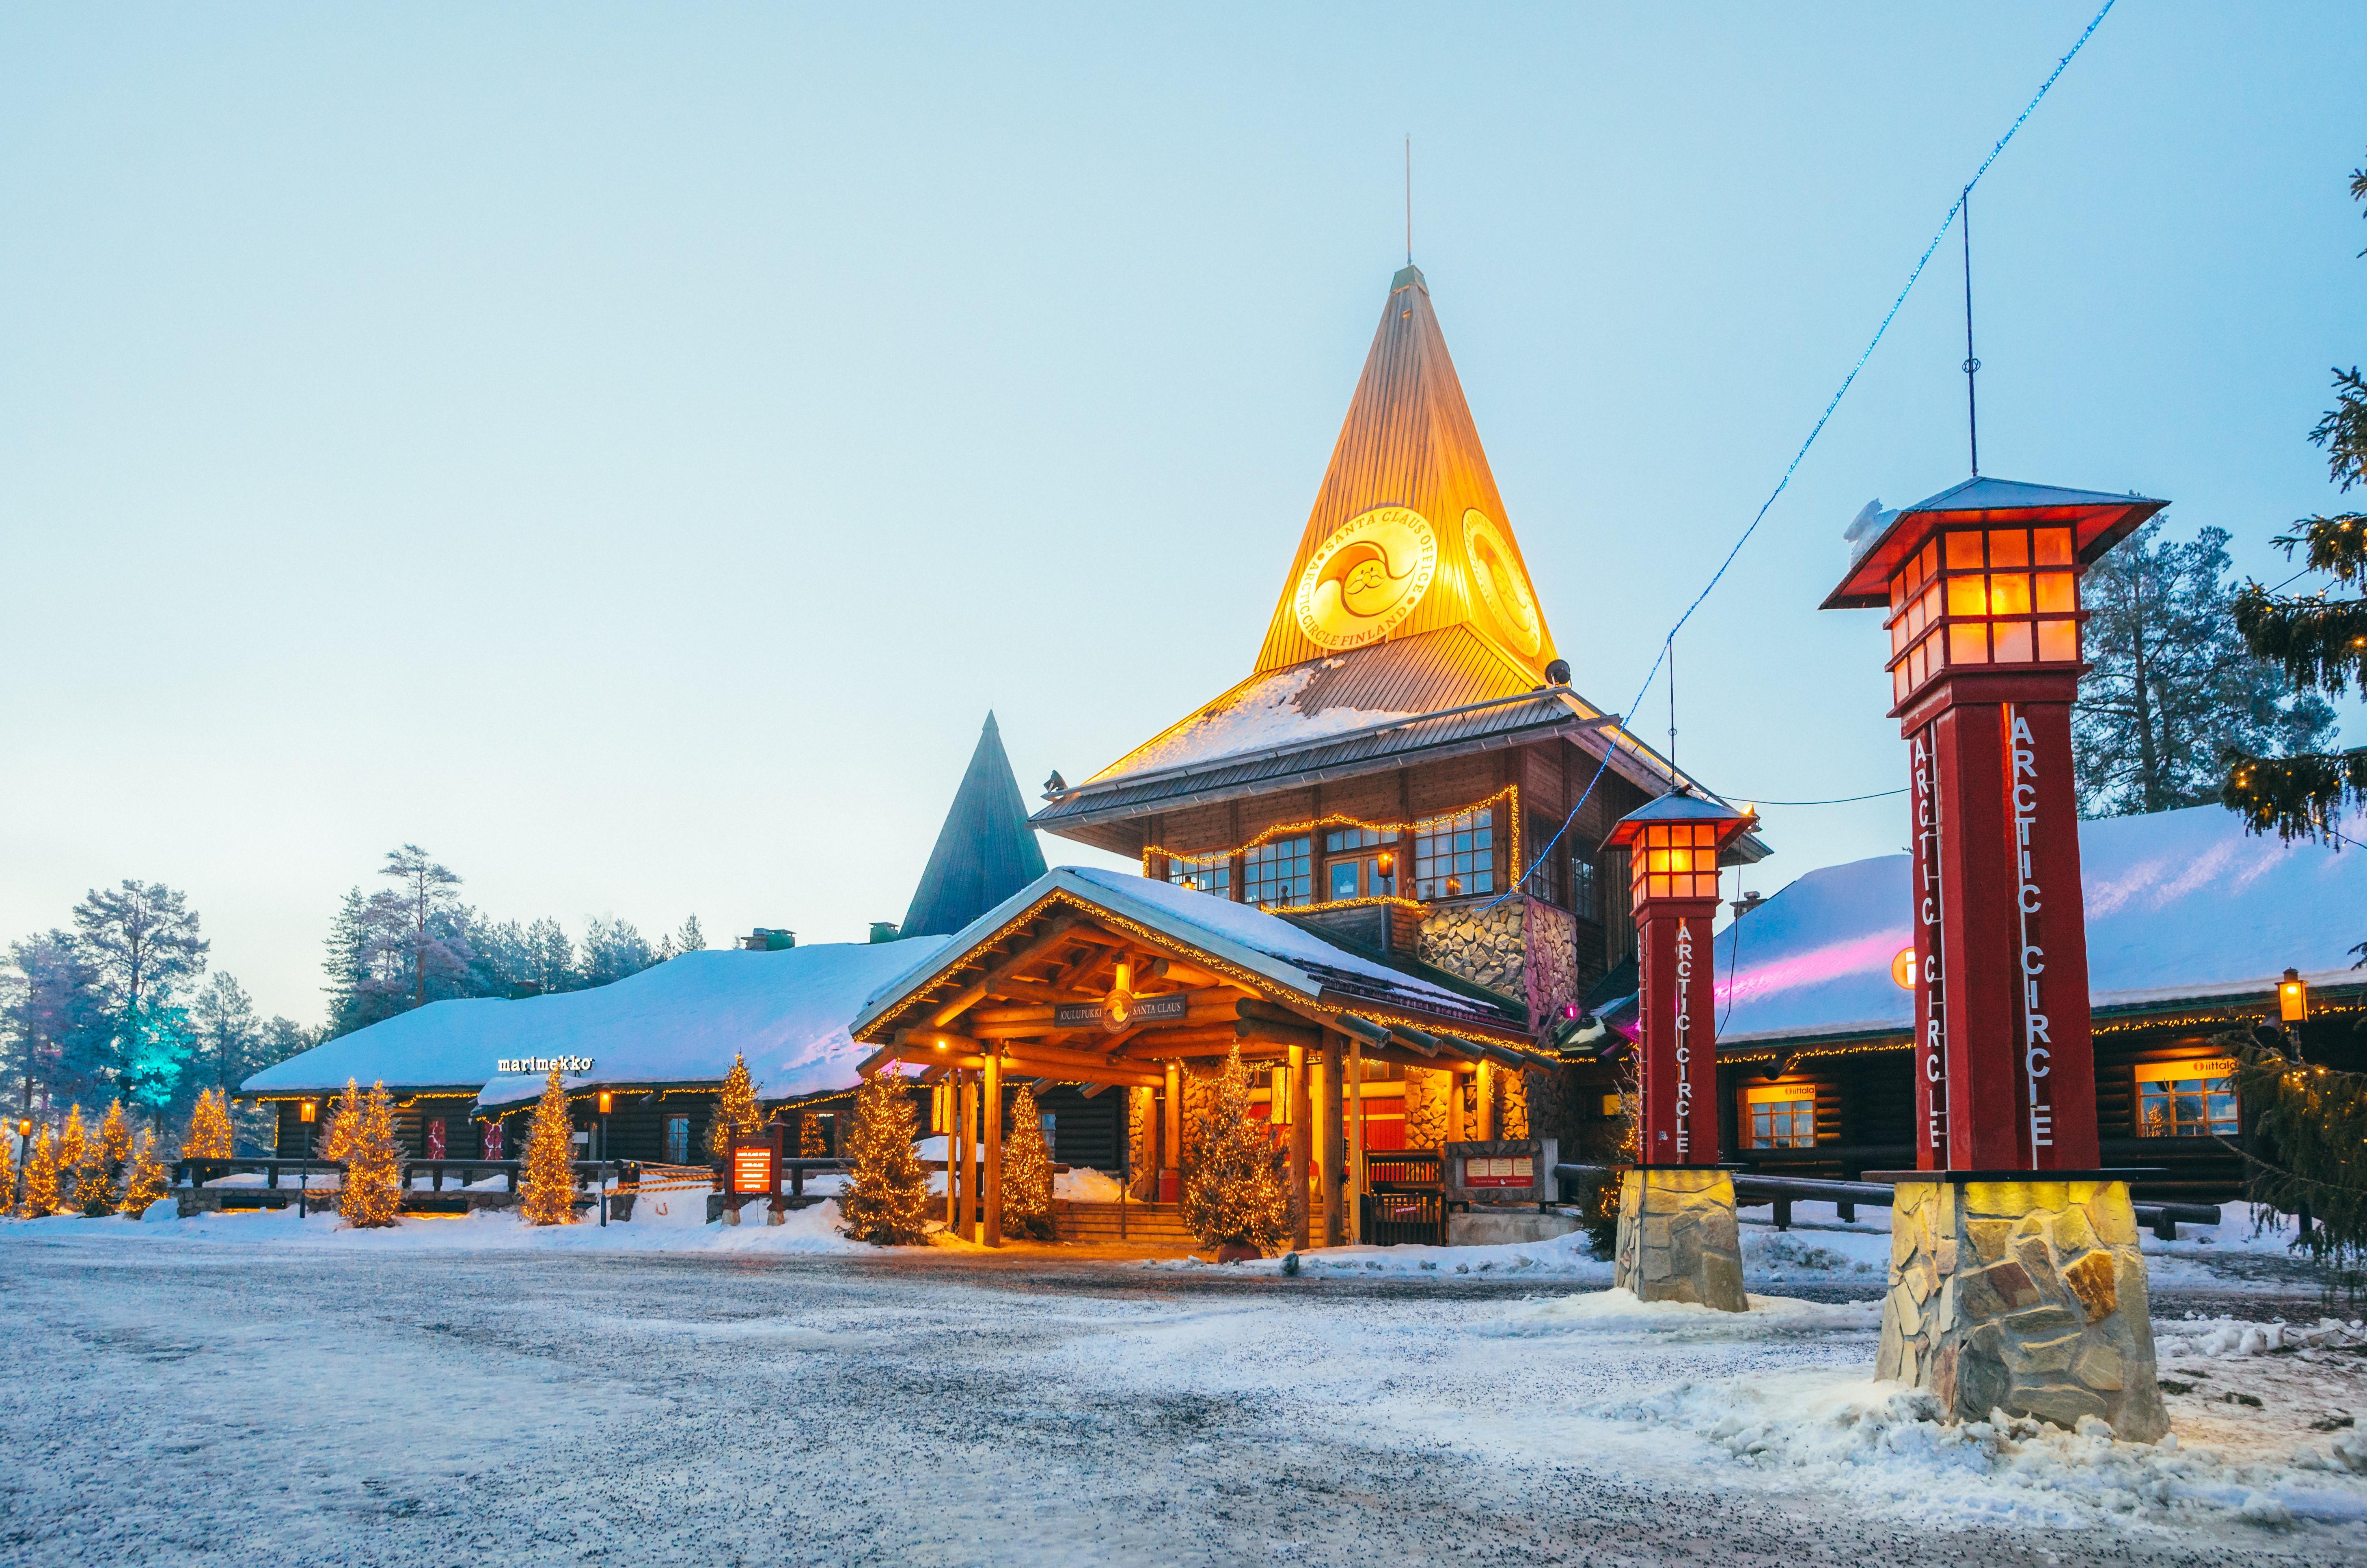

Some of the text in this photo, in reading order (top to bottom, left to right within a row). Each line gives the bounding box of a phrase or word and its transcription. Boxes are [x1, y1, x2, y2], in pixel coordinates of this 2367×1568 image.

[1326, 511, 1433, 593] SANTA CLAUS OFFICE
[1465, 526, 1481, 580] ARCTIC
[1300, 561, 1407, 646] ARCTIC CIRCLE FINLAND
[1520, 579, 1538, 634] OFFICE
[1914, 737, 1940, 1147] ARCTIC CIRCLE
[2009, 717, 2053, 1145] ARCTIC CIRCLE
[1060, 1002, 1181, 1021] JOULUPUKKI SANTA CLAUS
[1676, 926, 1693, 1153] ARCTIC CIRCLE
[498, 1055, 592, 1072] marimekko
